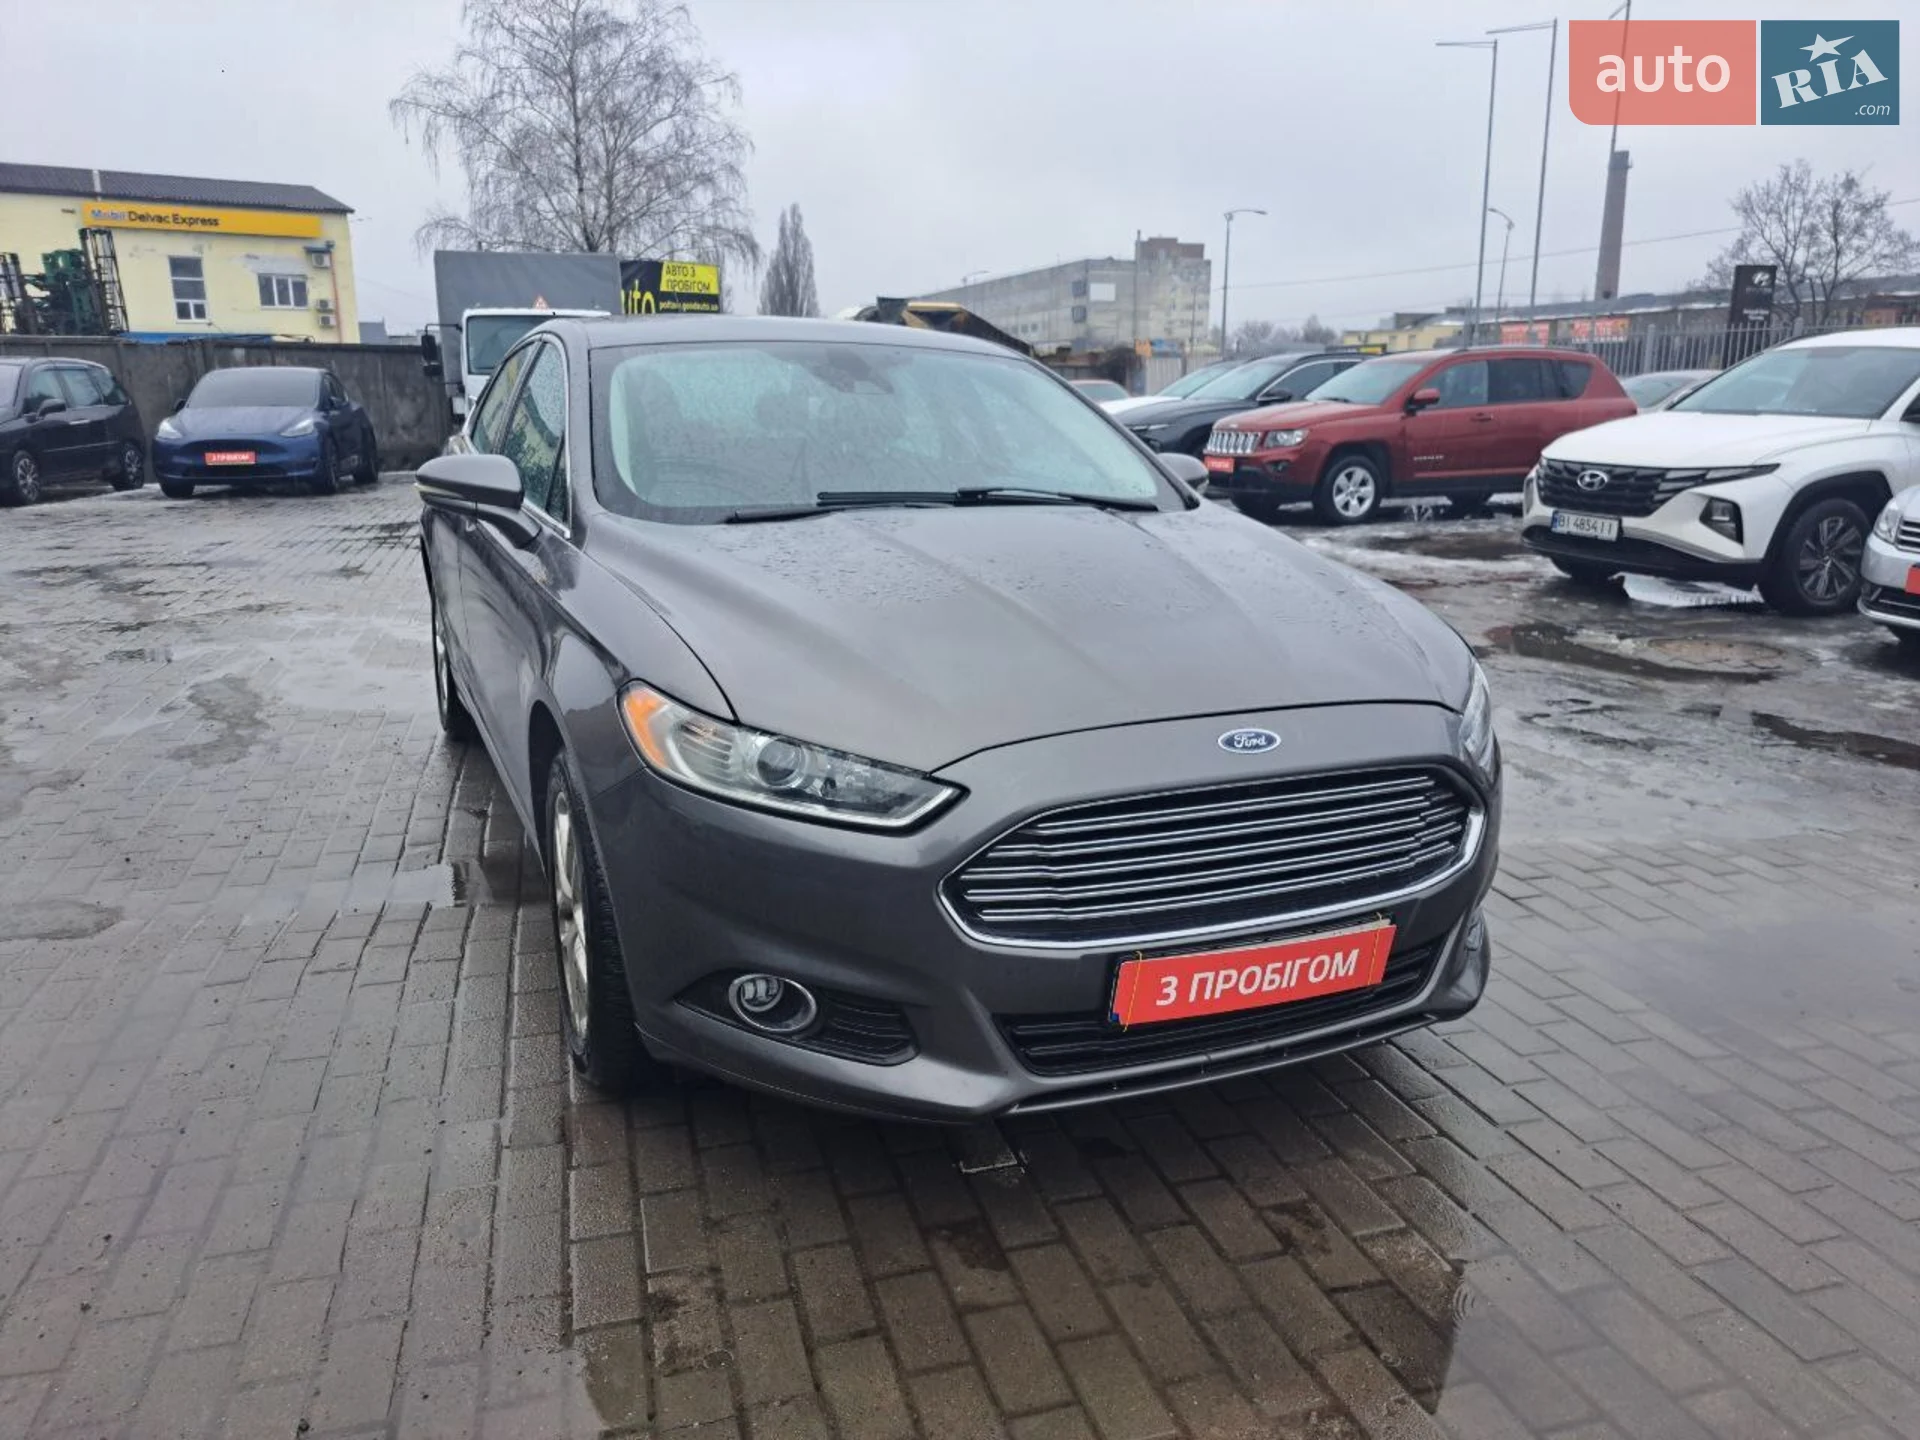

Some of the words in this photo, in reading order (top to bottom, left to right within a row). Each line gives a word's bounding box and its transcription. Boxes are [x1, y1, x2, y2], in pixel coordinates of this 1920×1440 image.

[128, 211, 170, 224] Delvac
[172, 213, 219, 227] Express
[666, 264, 689, 277] АВТО
[1233, 732, 1267, 748] Ford
[1156, 975, 1179, 1006] З
[1188, 948, 1360, 1003] ПРОБІГОМ
